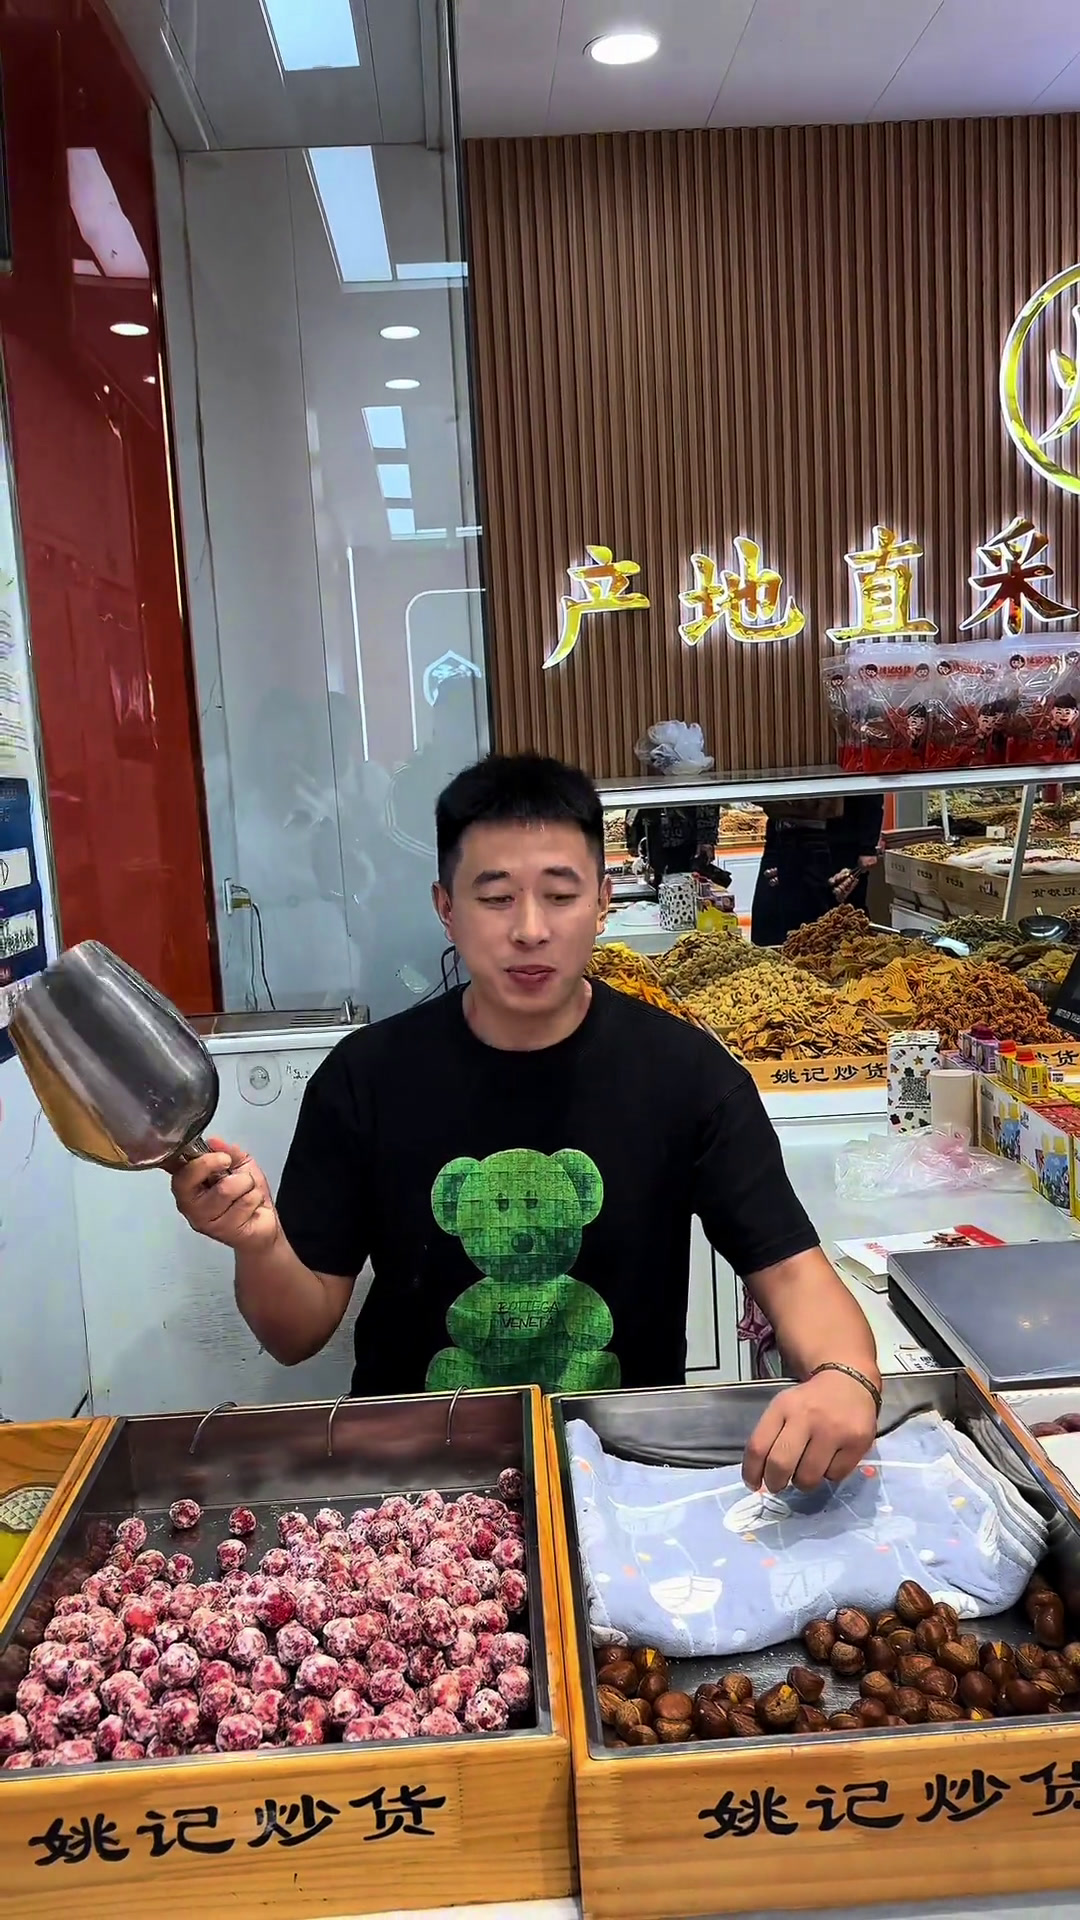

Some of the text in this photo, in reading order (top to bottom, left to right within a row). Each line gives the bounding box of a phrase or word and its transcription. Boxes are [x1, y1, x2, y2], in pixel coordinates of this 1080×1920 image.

[543, 516, 1079, 669] 产地直采
[771, 1063, 887, 1084] 姚记炒货
[497, 1301, 560, 1315] BOTTEGA
[501, 1316, 555, 1329] VENETA
[28, 1784, 447, 1866] 姚记炒货
